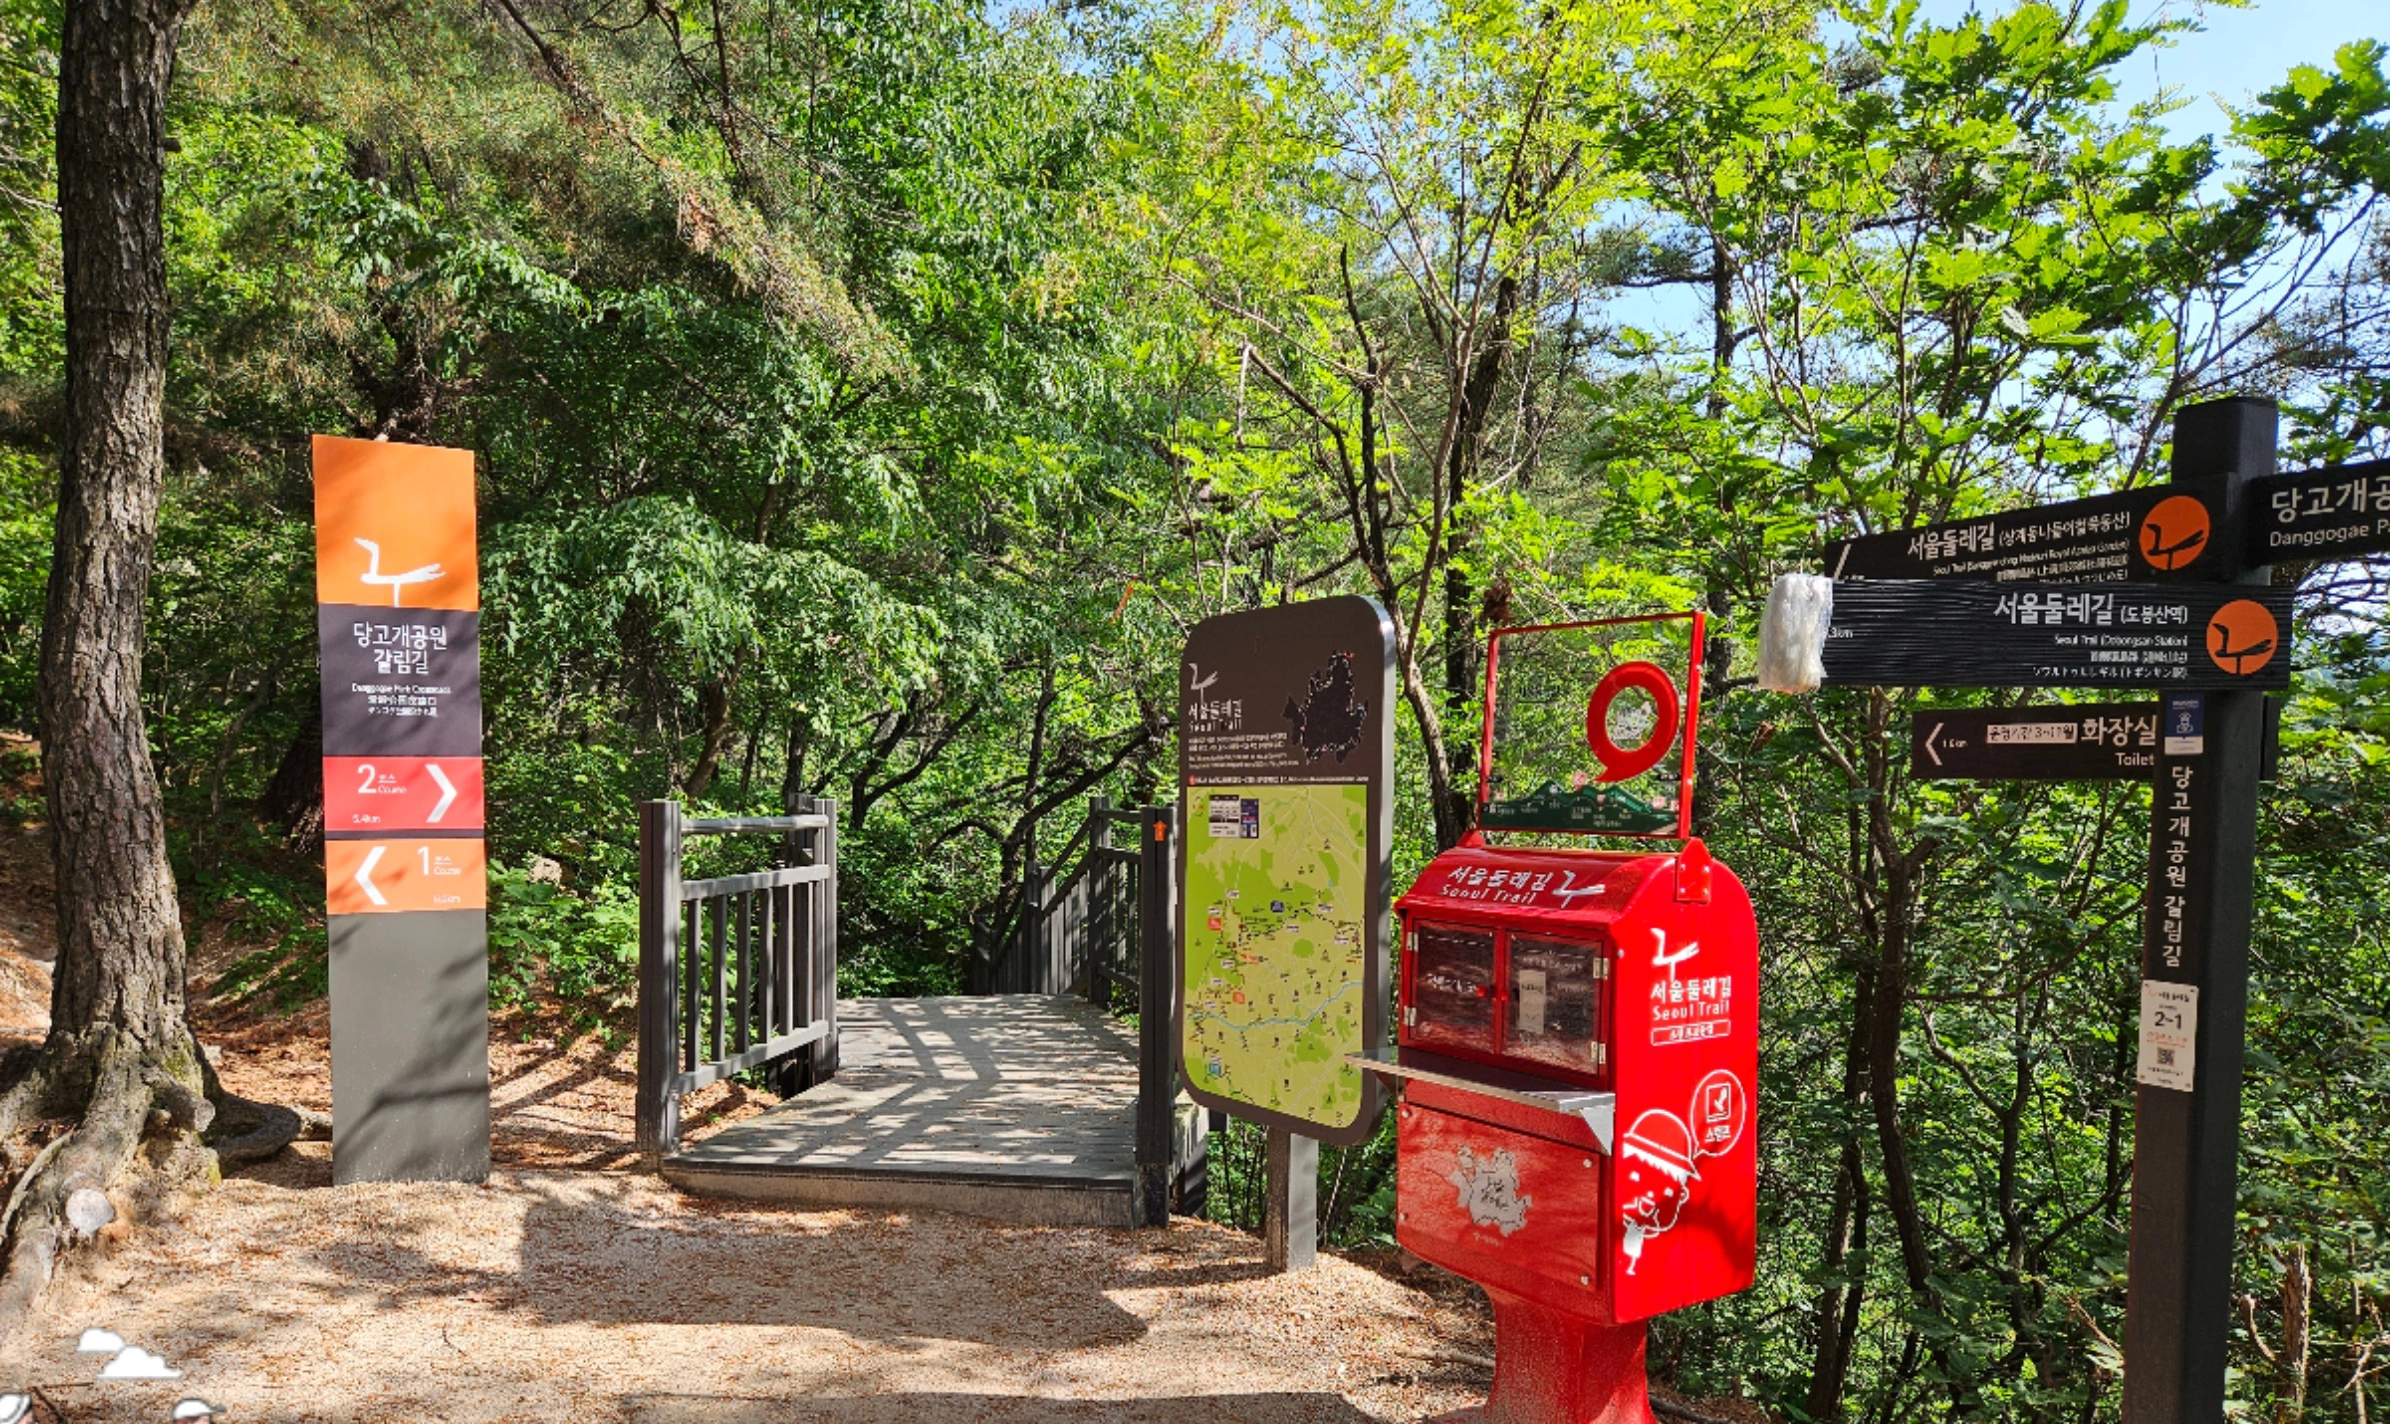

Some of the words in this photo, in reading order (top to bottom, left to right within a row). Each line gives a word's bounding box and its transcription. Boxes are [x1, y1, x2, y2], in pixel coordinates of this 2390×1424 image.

[1907, 521, 1996, 561] 서울둘레길
[2270, 524, 2370, 547] Danggogae
[2377, 517, 2390, 535] P
[1993, 592, 2114, 626] 서울둘레길
[2120, 605, 2188, 625] (도봉산역)
[353, 621, 448, 650] 당고개공원
[373, 648, 430, 675] 갈림길
[1188, 698, 1242, 723] 서울둘레길
[2080, 714, 2157, 747] 화장실
[2114, 751, 2155, 767] Toilet
[357, 763, 377, 795] 2
[2164, 766, 2194, 888] 당고개공원
[417, 845, 430, 876] 1
[1440, 883, 1489, 900] Seoul
[1493, 889, 1537, 905] Trail
[1448, 866, 1553, 892] 서울둘레길
[2162, 896, 2187, 967] 갈림길
[1650, 975, 1732, 1005] 서울둘레길
[1653, 1003, 1695, 1021] Seoul
[1699, 999, 1730, 1017] Trail
